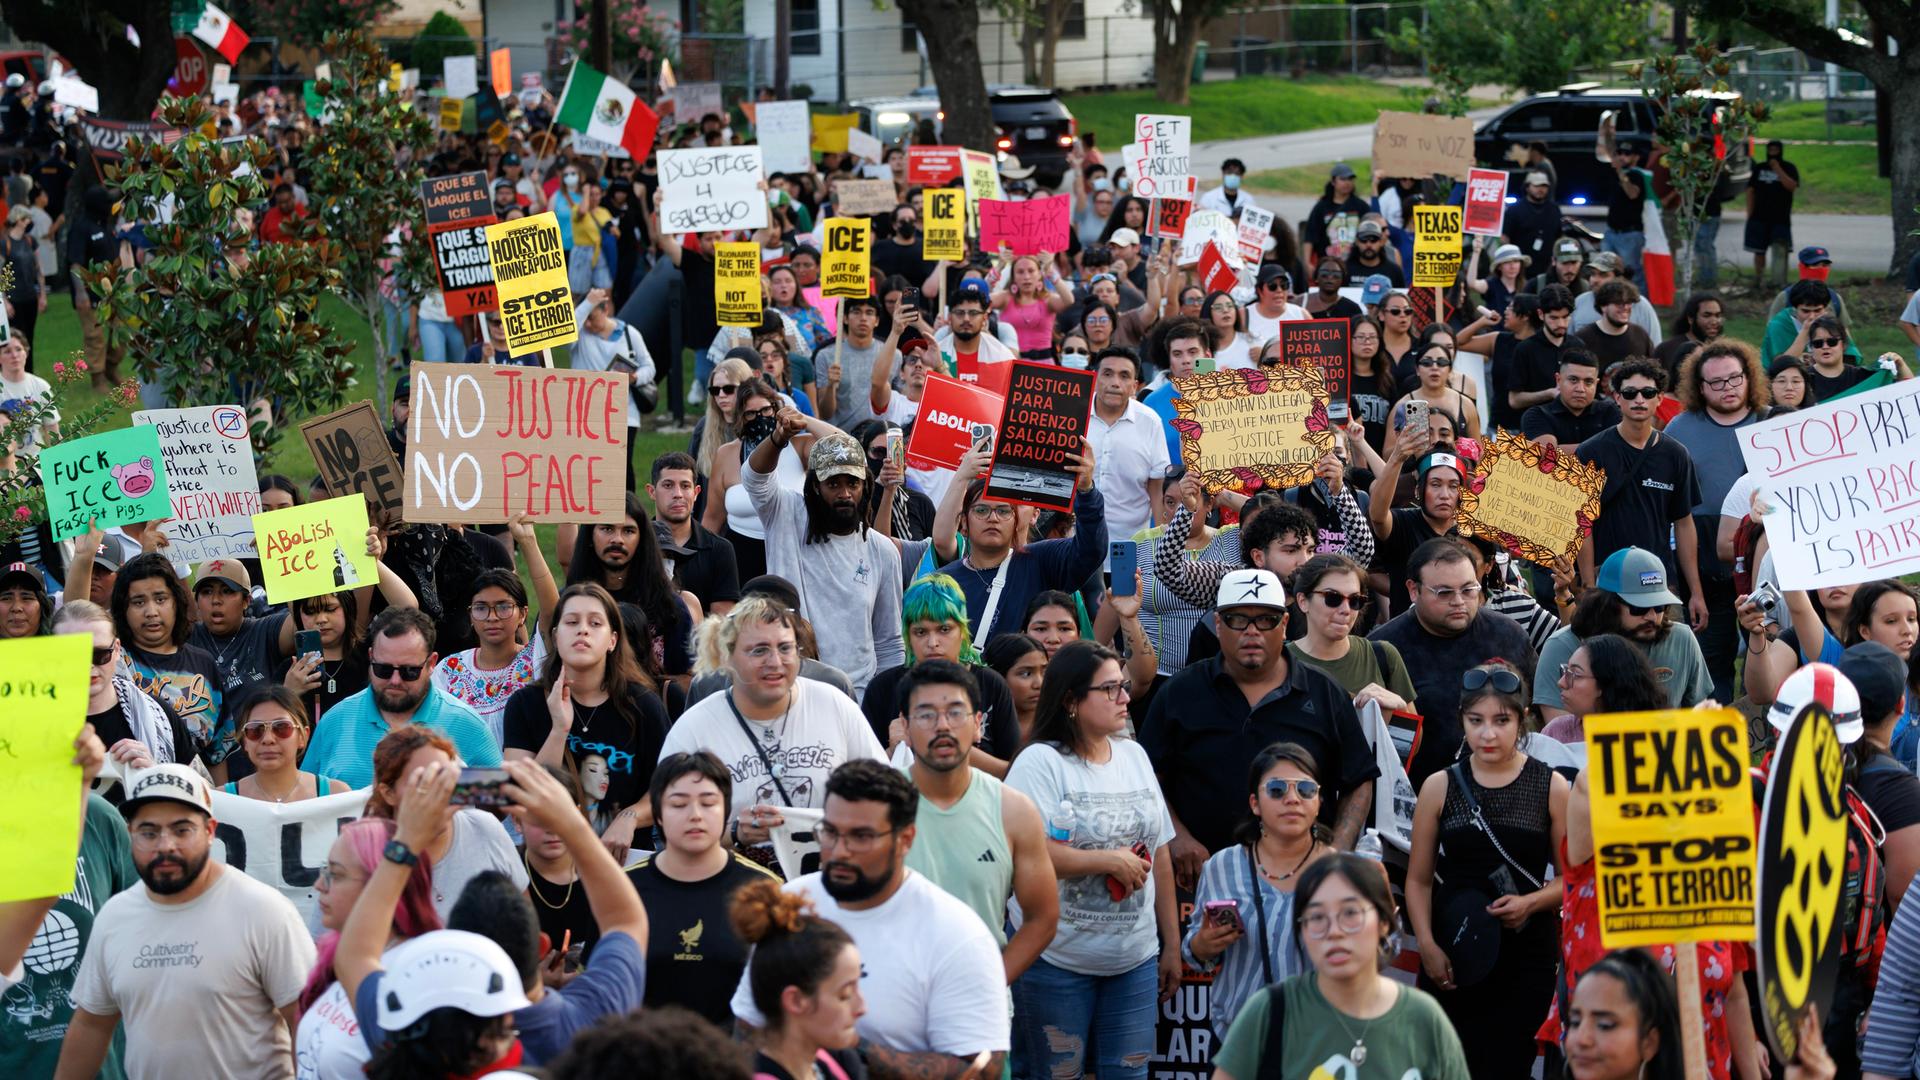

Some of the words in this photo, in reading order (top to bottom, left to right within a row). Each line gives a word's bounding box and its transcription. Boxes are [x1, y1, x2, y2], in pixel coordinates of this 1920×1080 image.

[1138, 116, 1181, 138] GET
[1139, 138, 1174, 156] THE
[1437, 136, 1466, 158] VOZ
[664, 152, 759, 184] JUSTICE
[1137, 156, 1189, 177] FASCISTS
[462, 175, 476, 186] SE
[696, 183, 713, 199] 4
[1137, 177, 1182, 196] OUT!
[427, 194, 471, 208] LARGUE
[473, 190, 487, 200] EL
[1471, 188, 1499, 202] ICE
[448, 209, 471, 219] ICE!
[932, 194, 955, 219] ICE
[508, 225, 538, 237] FROM
[1416, 212, 1459, 233] TEXAS
[474, 227, 486, 243] S
[491, 227, 559, 264] HOUSTON
[828, 226, 865, 253] ICE
[439, 246, 490, 269] LARGU
[496, 251, 561, 282] MINNEAPOLIS
[521, 252, 536, 260] TO
[736, 259, 755, 269] THE
[1415, 252, 1460, 260] STOP
[445, 266, 495, 287] TRUM
[831, 262, 847, 273] OUT
[849, 263, 861, 273] OF
[1415, 262, 1428, 275] ICE
[826, 273, 865, 285] HOUSTON
[467, 291, 492, 307] YA!
[503, 287, 568, 314] STOP
[505, 313, 525, 336] ICE
[527, 302, 572, 331] TERROR
[1287, 329, 1341, 341] JUSTICIA
[1287, 343, 1321, 354] PARA
[1015, 375, 1081, 398] JUSTICIA
[414, 370, 486, 443] NO
[494, 370, 620, 444] JUSTICE
[1012, 391, 1053, 410] PARA
[1195, 402, 1210, 418] NO
[1215, 397, 1254, 417] HUMAN
[1256, 396, 1267, 410] IS
[1270, 393, 1311, 409] ILLEGAL
[1009, 409, 1077, 432] LORENZO
[1238, 416, 1257, 429] LIFE
[221, 440, 237, 453] is
[1005, 425, 1078, 449] SALGADO
[1229, 430, 1285, 450] JUSTICE
[1751, 410, 1858, 473] STOP
[315, 428, 360, 481] NO
[1001, 443, 1065, 464] ARAUJO
[1200, 454, 1219, 471] FOR
[1222, 451, 1273, 468] LORENZO
[54, 450, 110, 485] FUCK
[166, 458, 208, 477] threat
[217, 459, 238, 475] to
[169, 481, 203, 492] stice
[414, 451, 483, 511] NO
[501, 451, 604, 518] PEACE
[1774, 475, 1870, 542] YOUR
[1805, 535, 1855, 575] IS
[1593, 725, 1742, 795] TEXAS
[1600, 836, 1751, 868] STOP
[1603, 872, 1645, 909] ICE
[1650, 866, 1753, 906] TERROR
[133, 954, 203, 969] Community
[1162, 985, 1212, 1025] QU
